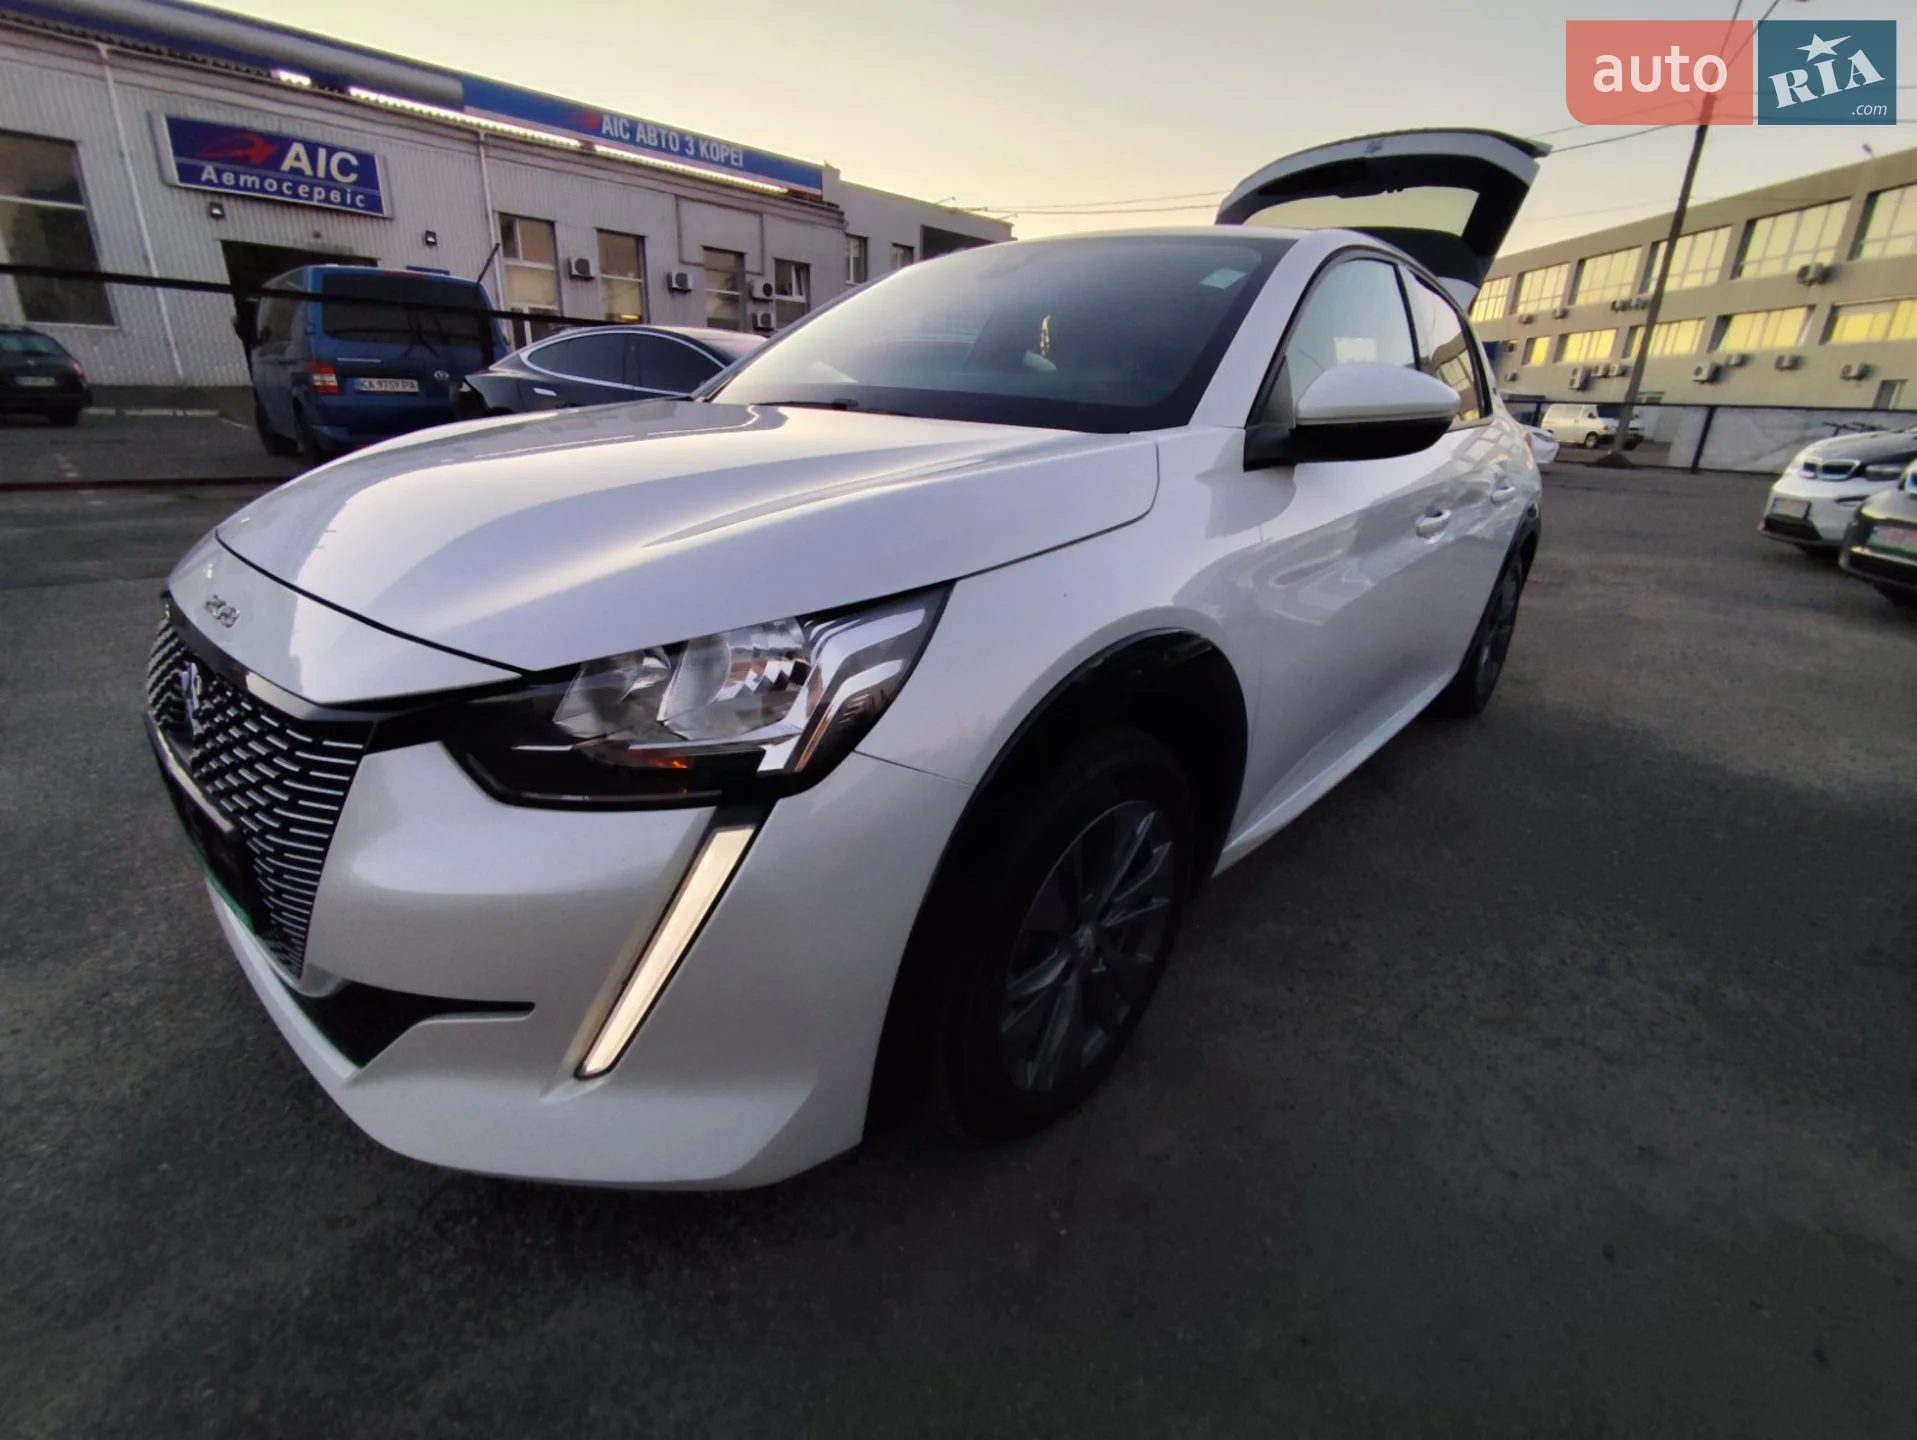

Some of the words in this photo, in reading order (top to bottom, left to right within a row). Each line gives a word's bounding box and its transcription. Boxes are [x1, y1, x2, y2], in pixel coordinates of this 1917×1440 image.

[636, 123, 680, 153] АВТО
[684, 136, 695, 156] З
[280, 142, 359, 184] АІС
[201, 165, 366, 207] Автосервіс
